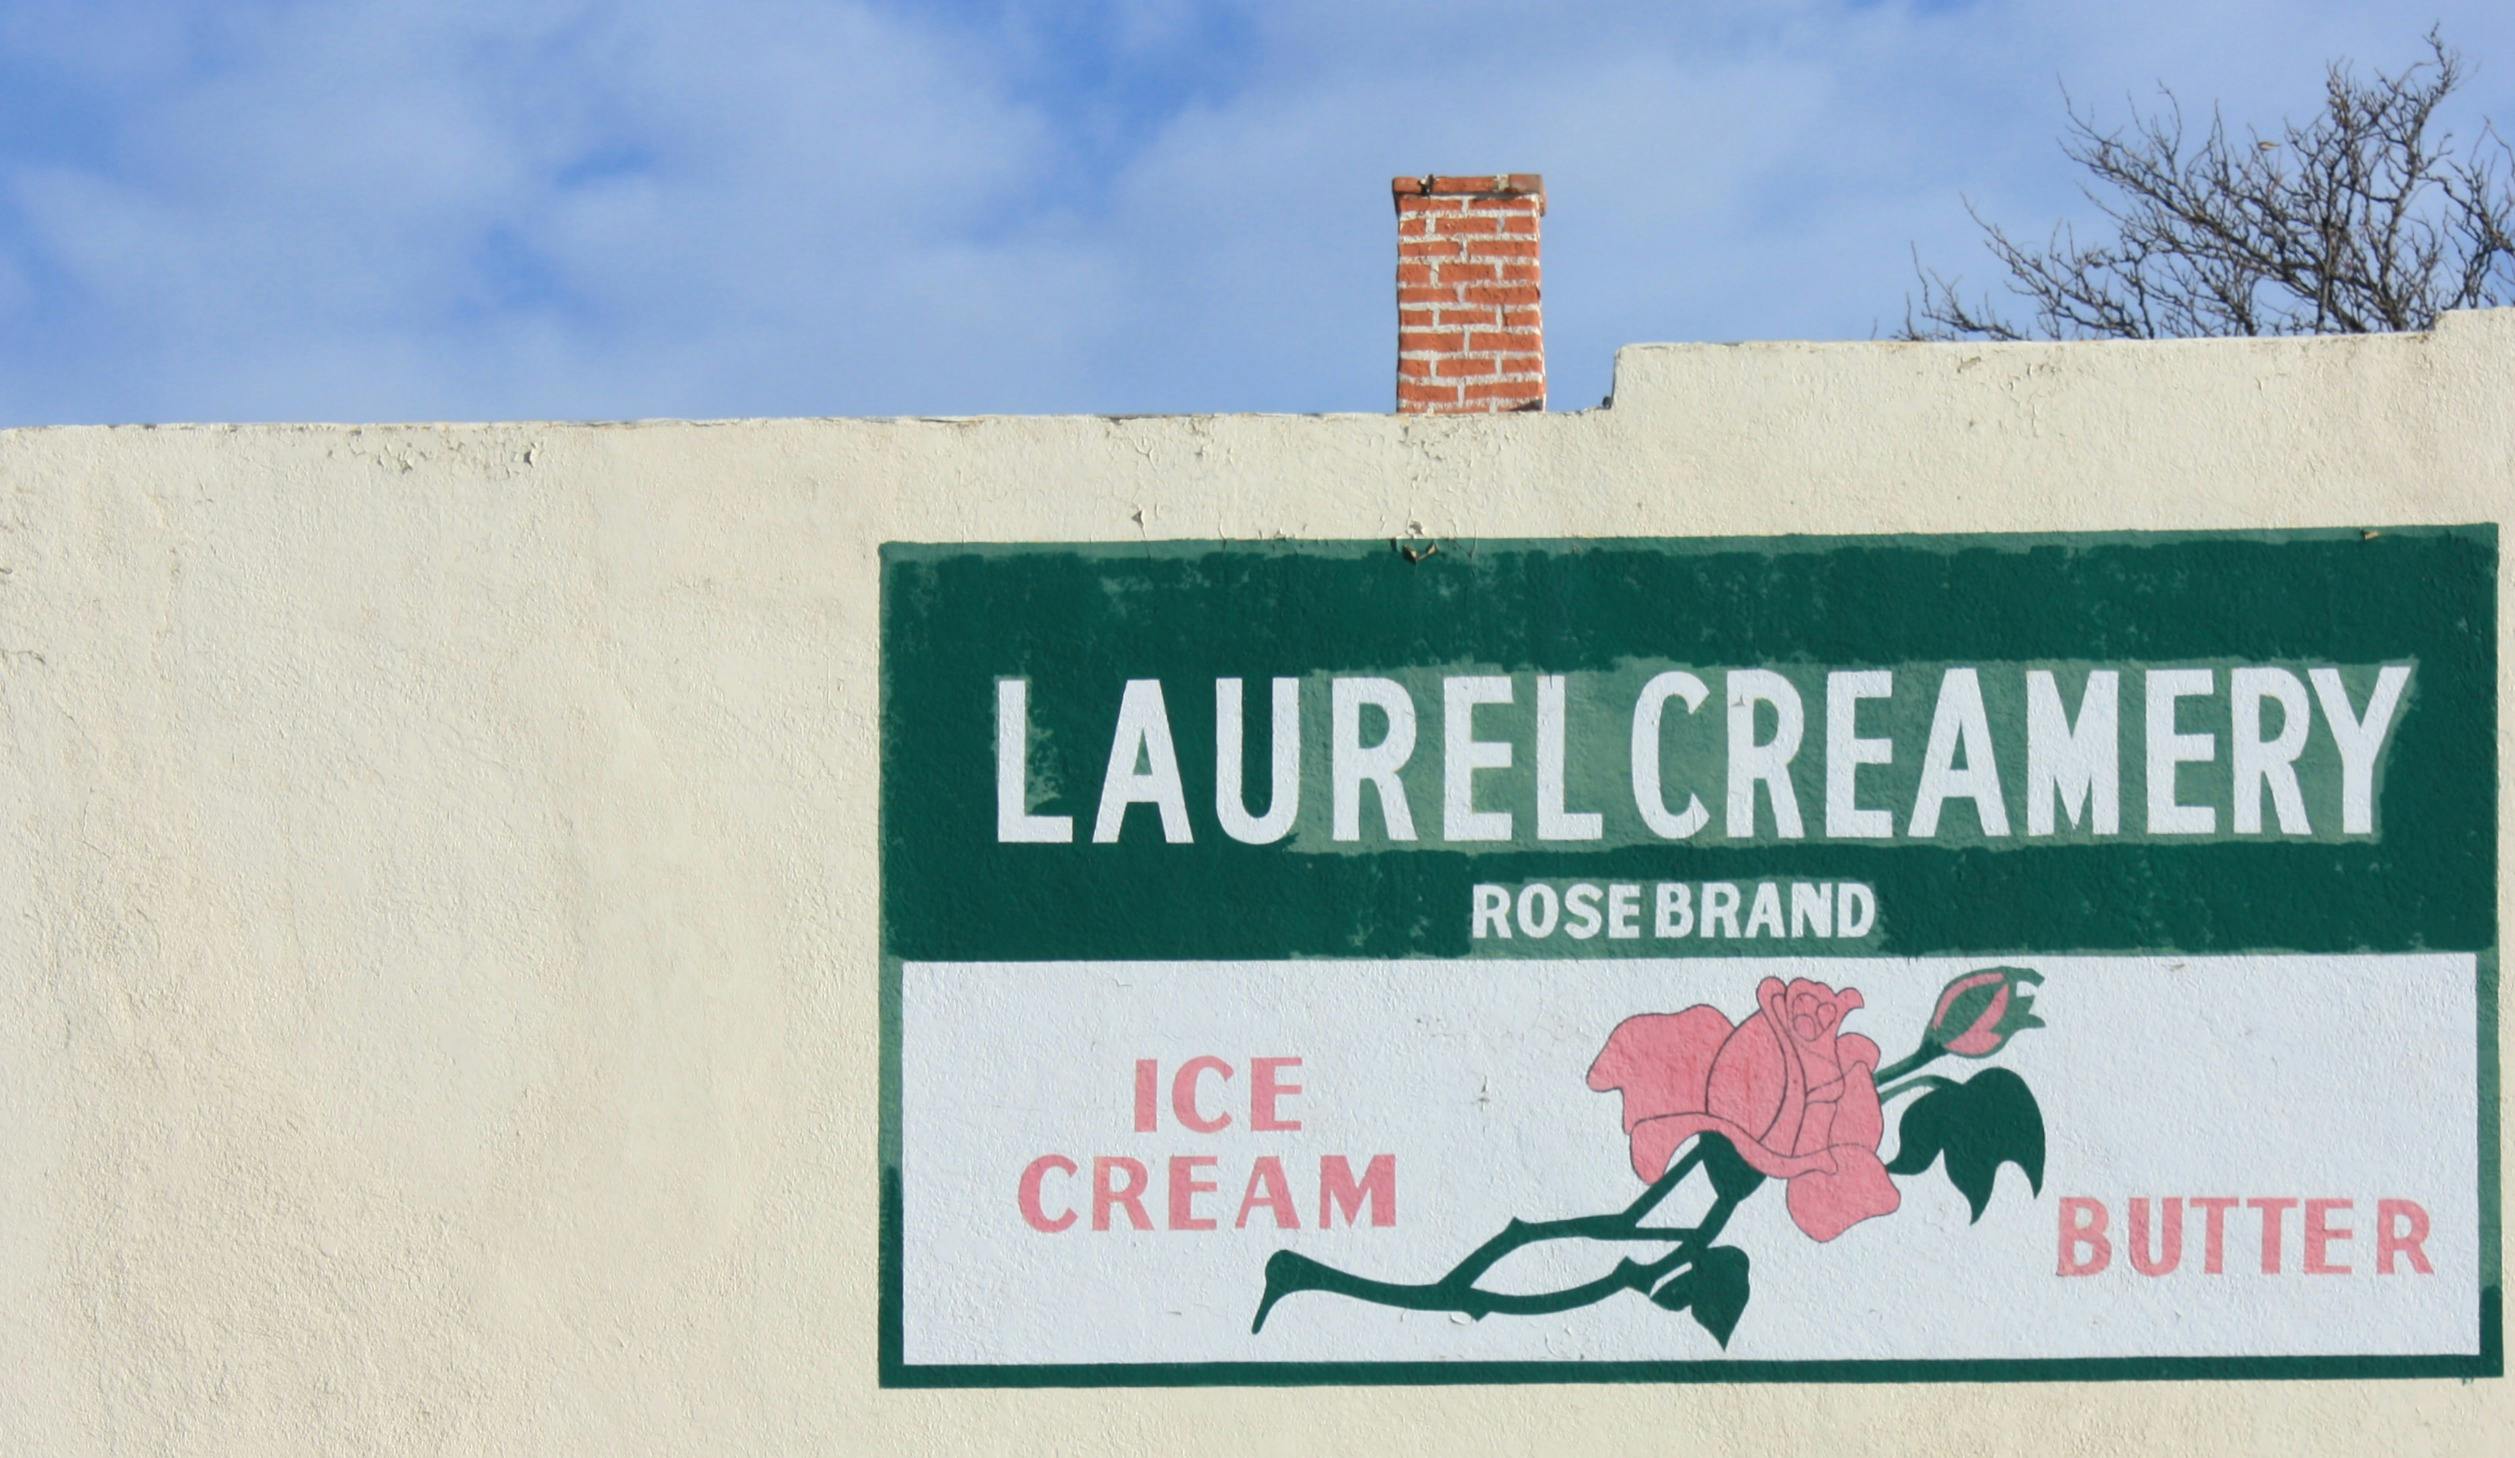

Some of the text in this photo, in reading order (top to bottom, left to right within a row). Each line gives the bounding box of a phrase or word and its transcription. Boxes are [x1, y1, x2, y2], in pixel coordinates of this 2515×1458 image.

[996, 664, 2412, 845] LAUREL CREAMERY
[1471, 881, 1876, 941] ROSE BRAND
[1133, 1055, 1304, 1134] ICE
[1017, 1152, 1398, 1234] CREAM
[2056, 1195, 2434, 1278] BUTTER
